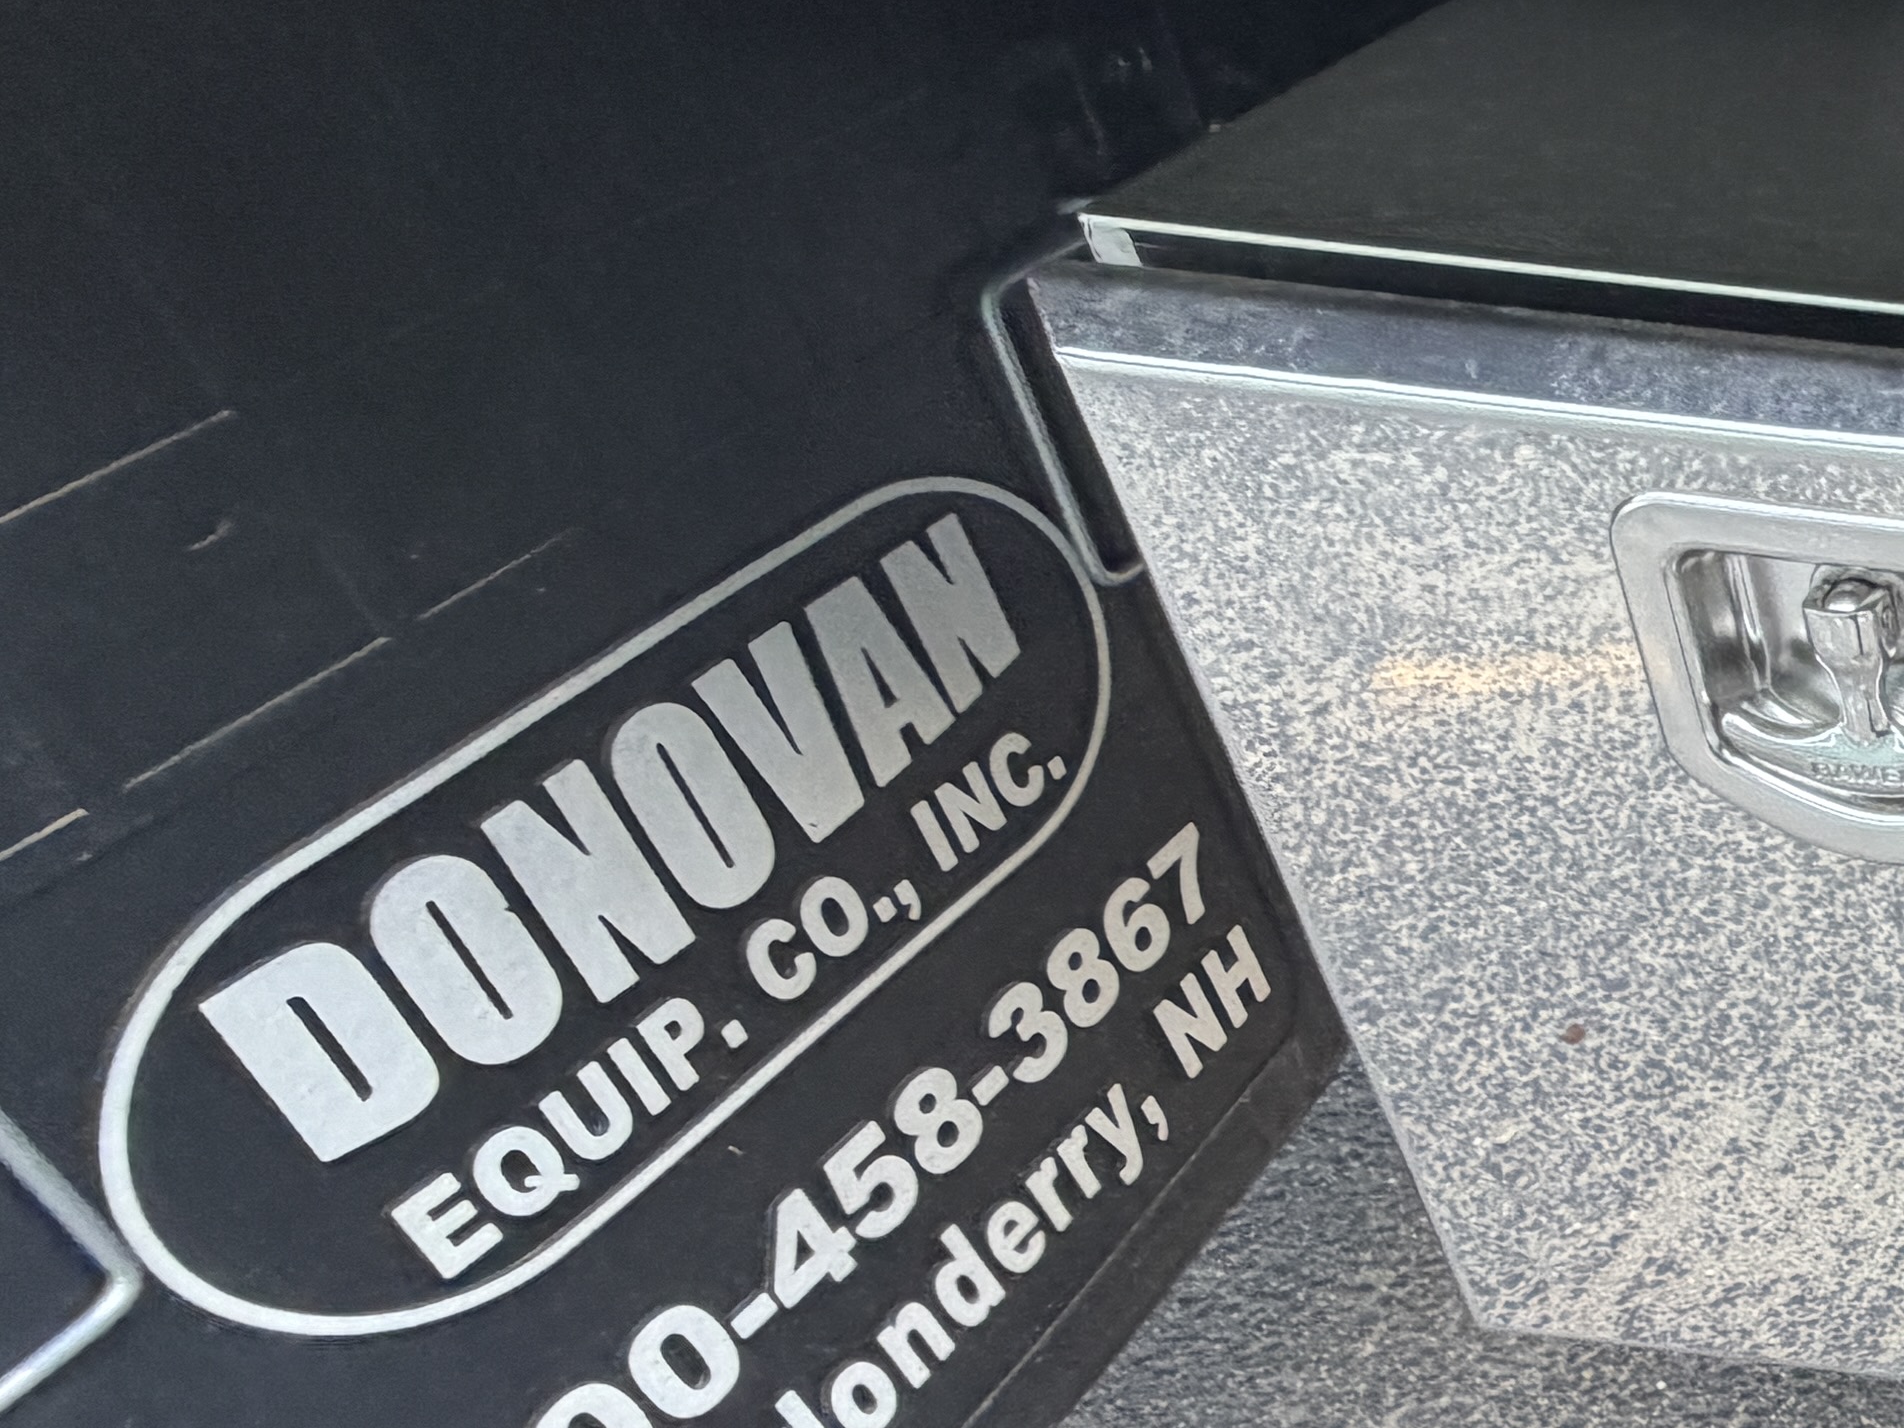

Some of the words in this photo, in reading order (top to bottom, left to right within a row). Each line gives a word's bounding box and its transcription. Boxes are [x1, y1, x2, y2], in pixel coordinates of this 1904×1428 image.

[198, 514, 1019, 1162] DONOVAN
[391, 998, 748, 1279] EQUIP.
[746, 877, 921, 999] CO.,
[911, 733, 1066, 871] INC.
[1153, 925, 1271, 1078] NH
